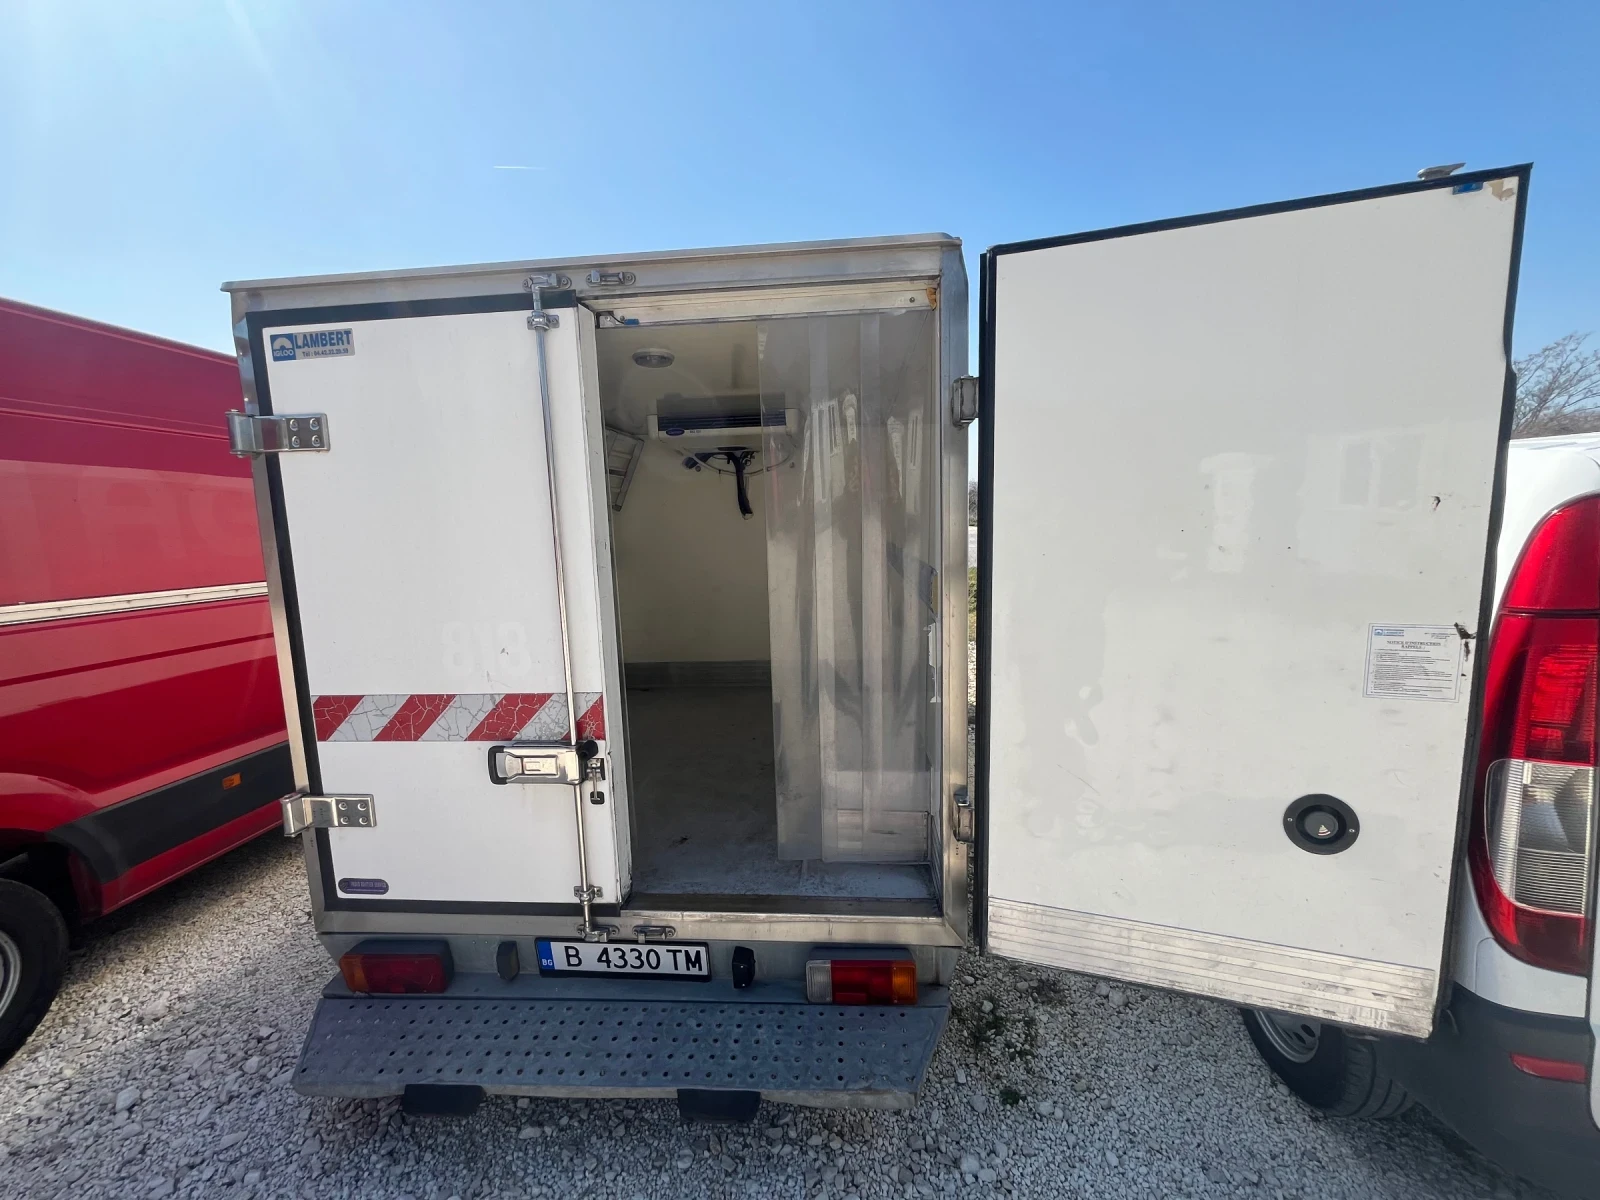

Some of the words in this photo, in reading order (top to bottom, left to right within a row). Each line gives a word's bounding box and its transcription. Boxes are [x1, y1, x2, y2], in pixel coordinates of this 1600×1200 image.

[294, 331, 352, 349] LAMBERT
[273, 349, 295, 357] IGLOO
[541, 958, 553, 966] BG
[564, 945, 582, 968] B
[597, 947, 661, 970] 4330
[666, 949, 703, 972] TM
